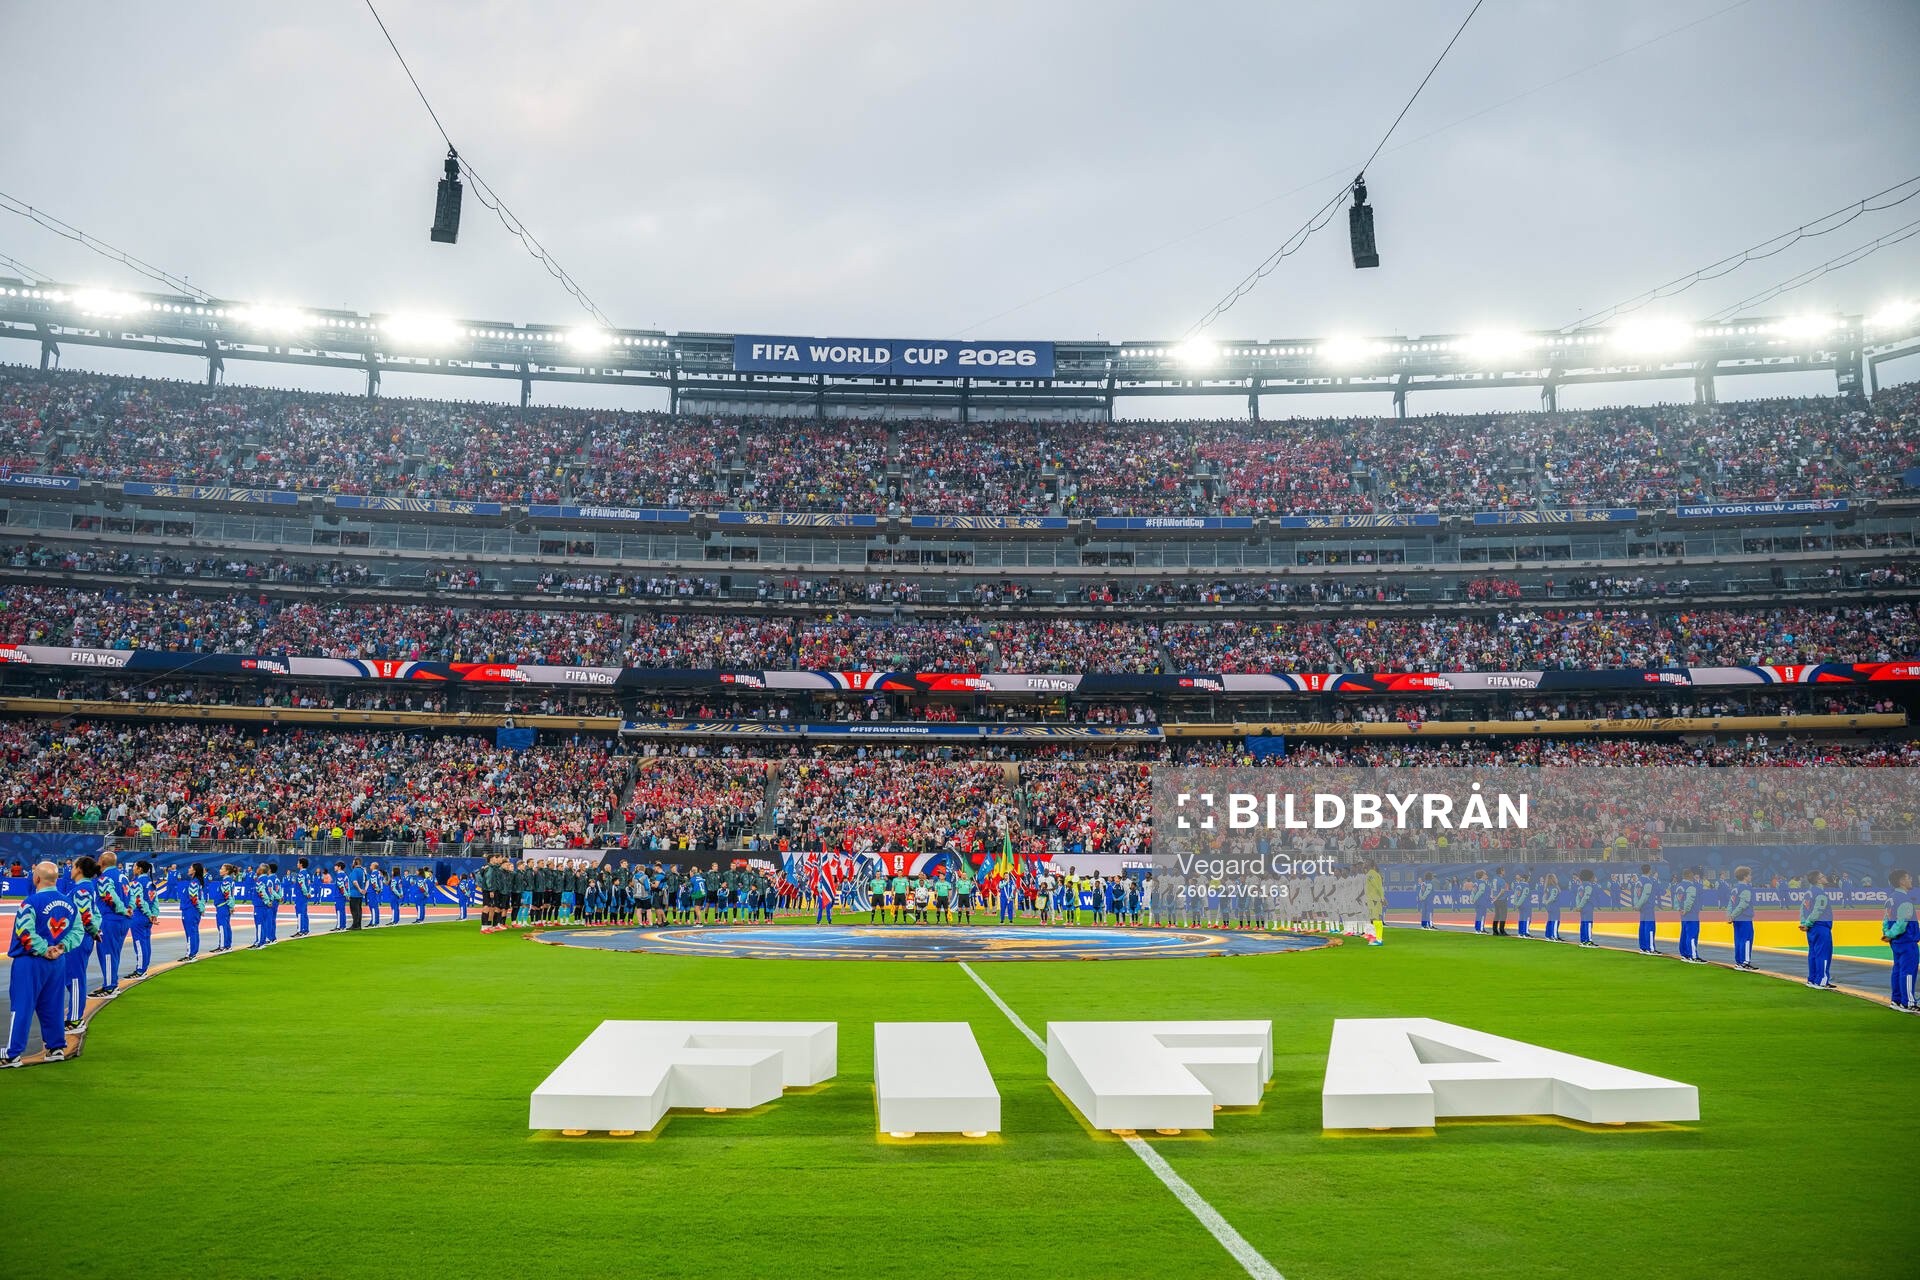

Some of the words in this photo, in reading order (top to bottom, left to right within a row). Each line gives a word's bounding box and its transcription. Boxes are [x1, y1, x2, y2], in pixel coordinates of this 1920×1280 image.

[752, 344, 800, 361] FIFA
[810, 346, 891, 364] WORLD
[903, 347, 949, 365] CUP
[958, 349, 1037, 366] 2026
[14, 476, 71, 487] JERSEY
[579, 508, 640, 520] #FIFAWorldCup
[1684, 507, 1713, 515] NEW
[1716, 505, 1752, 513] YORK
[1755, 504, 1785, 512] NEW
[1145, 518, 1205, 529] #FIFAWorldCup
[71, 652, 95, 664] FIFA
[565, 671, 587, 681] FIFA
[1028, 679, 1049, 689] FIFA
[1488, 677, 1510, 687] FIFA
[849, 726, 929, 734] #FIFAWorldCup
[1755, 892, 1780, 902] FIFA
[529, 1018, 1699, 1132] FIFA
